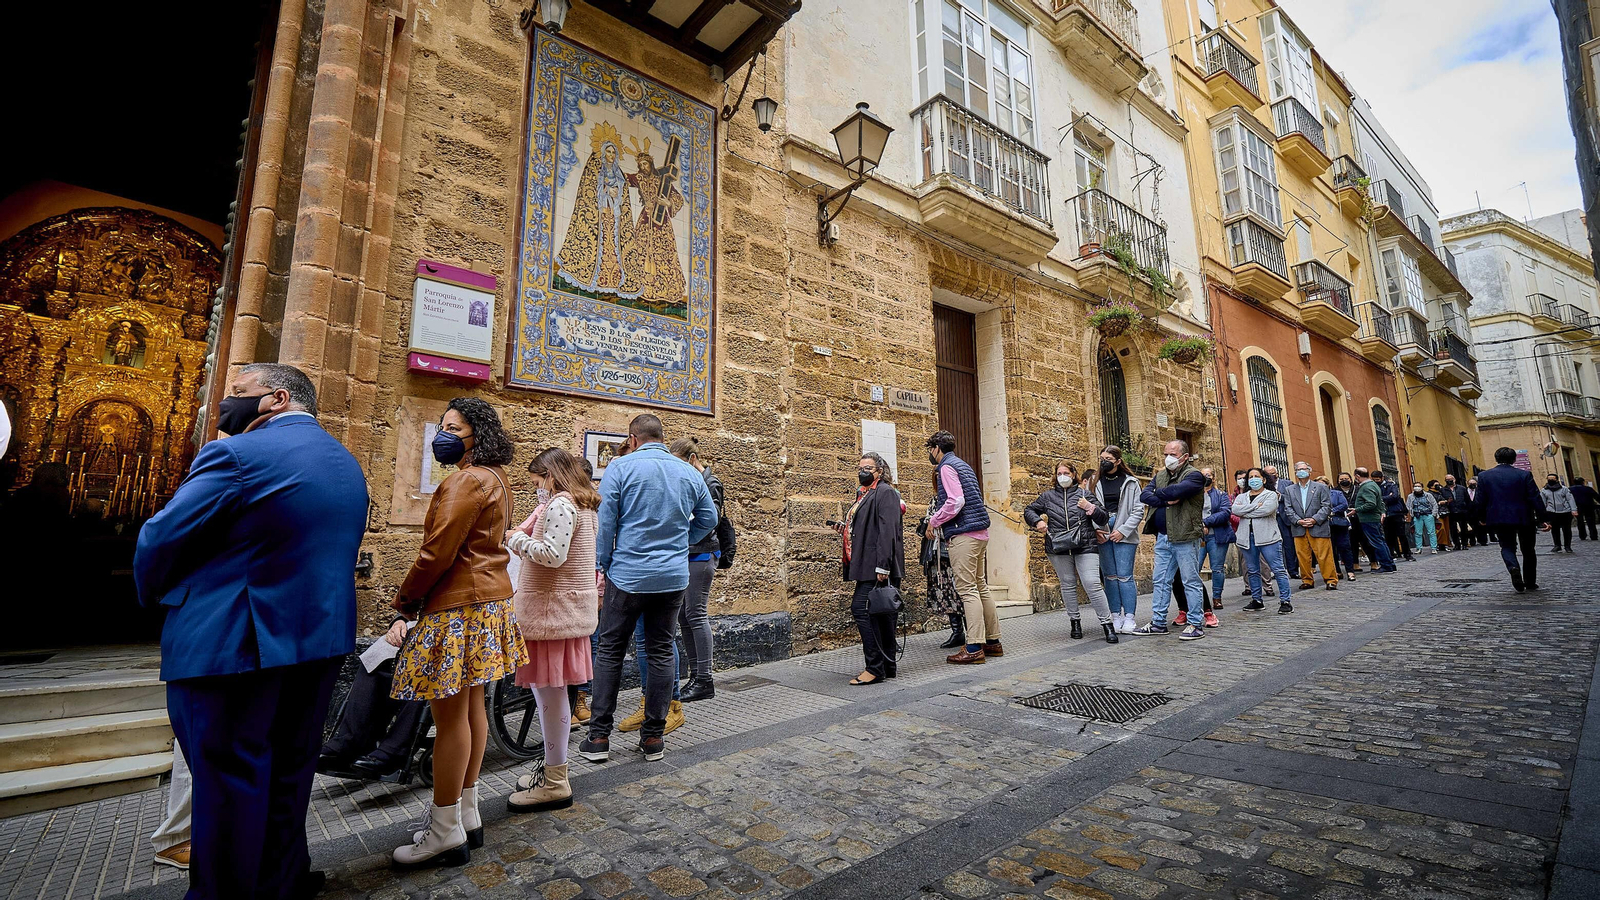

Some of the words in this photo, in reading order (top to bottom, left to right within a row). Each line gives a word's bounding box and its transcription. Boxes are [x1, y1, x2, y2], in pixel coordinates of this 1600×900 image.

[424, 288, 457, 300] Parroquia
[423, 296, 436, 304] San
[438, 299, 464, 310] Lorenzo
[423, 304, 445, 314] Mártir
[582, 322, 607, 333] JESVS
[617, 331, 632, 339] LOS
[634, 334, 670, 347] AFLIGIDOS
[566, 334, 583, 344] QVE
[585, 339, 595, 347] SE
[596, 341, 628, 353] VENERAN
[640, 350, 653, 358] ESTA
[653, 352, 675, 361] IGLESIA
[608, 336, 622, 345] LOS
[624, 339, 677, 356] DESCONSVELOS
[601, 370, 642, 385] 1726-1926
[896, 390, 923, 403] CAPILLA
